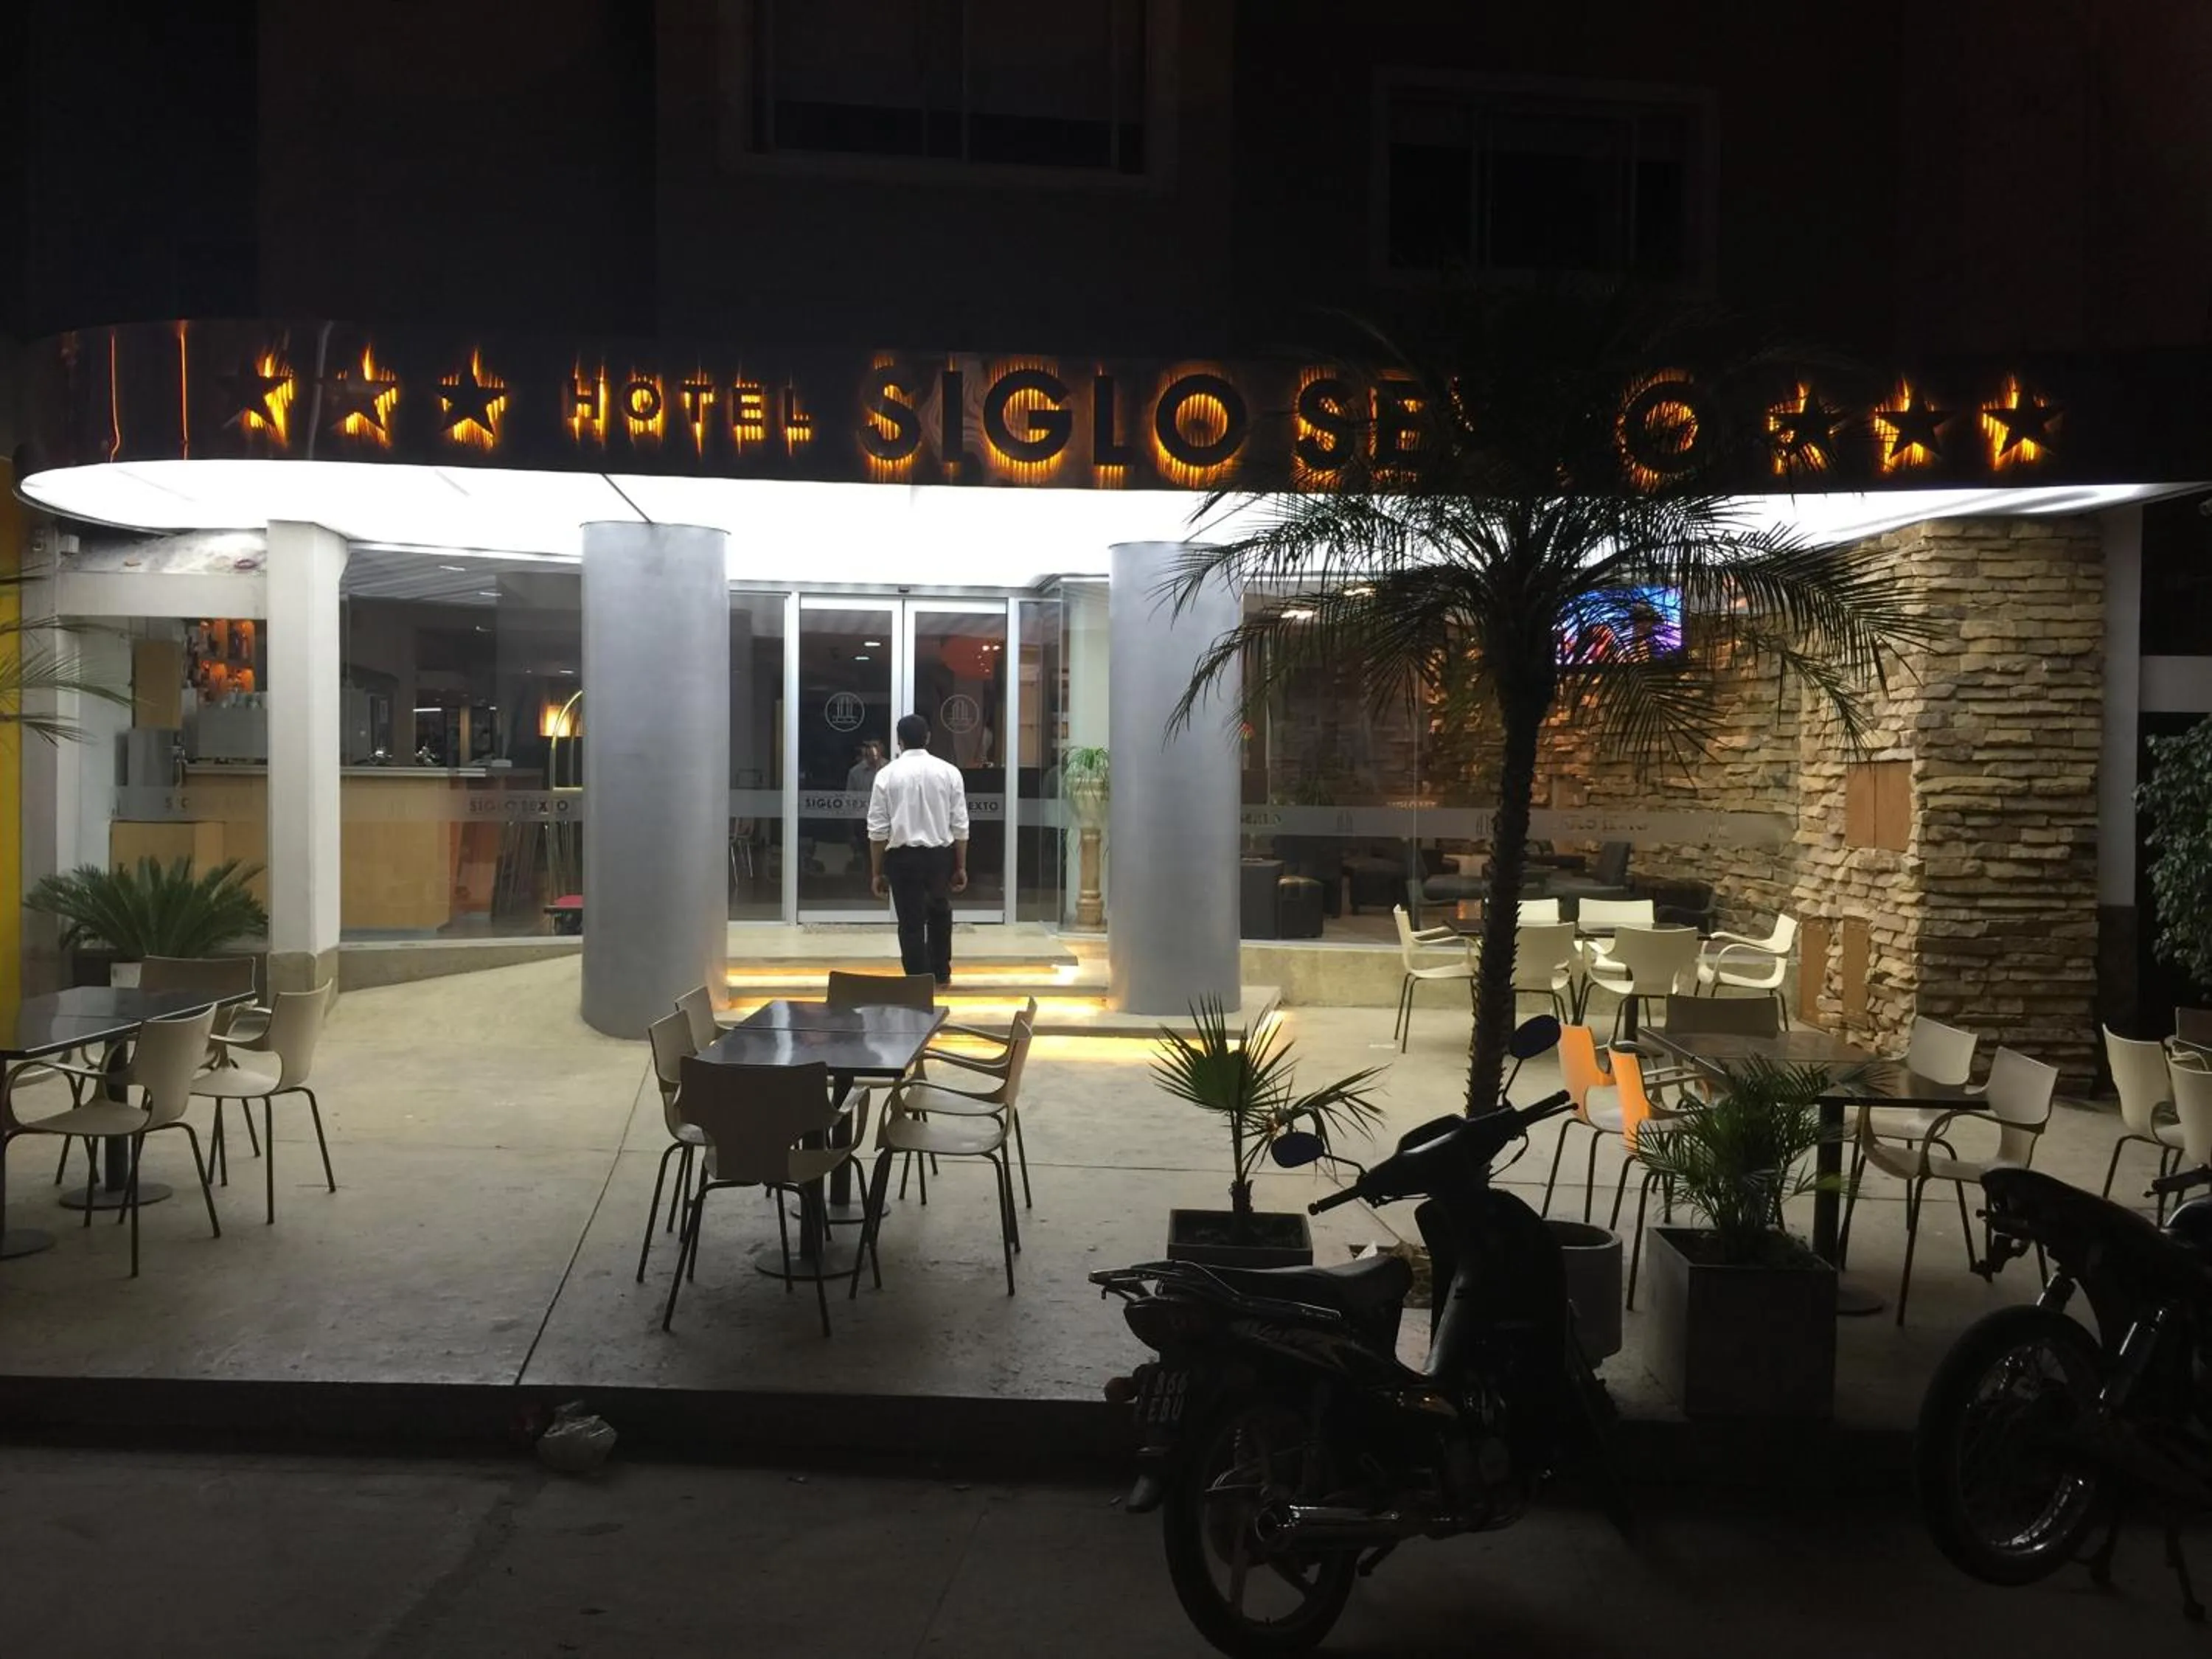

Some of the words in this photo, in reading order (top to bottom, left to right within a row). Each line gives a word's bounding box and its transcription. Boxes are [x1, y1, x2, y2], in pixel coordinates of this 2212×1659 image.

[566, 371, 810, 434] HOTEL
[859, 366, 1247, 468] SIGLO
[1296, 376, 1717, 476] SEO
[805, 798, 842, 809] SIGLO
[967, 801, 998, 811] EXTO
